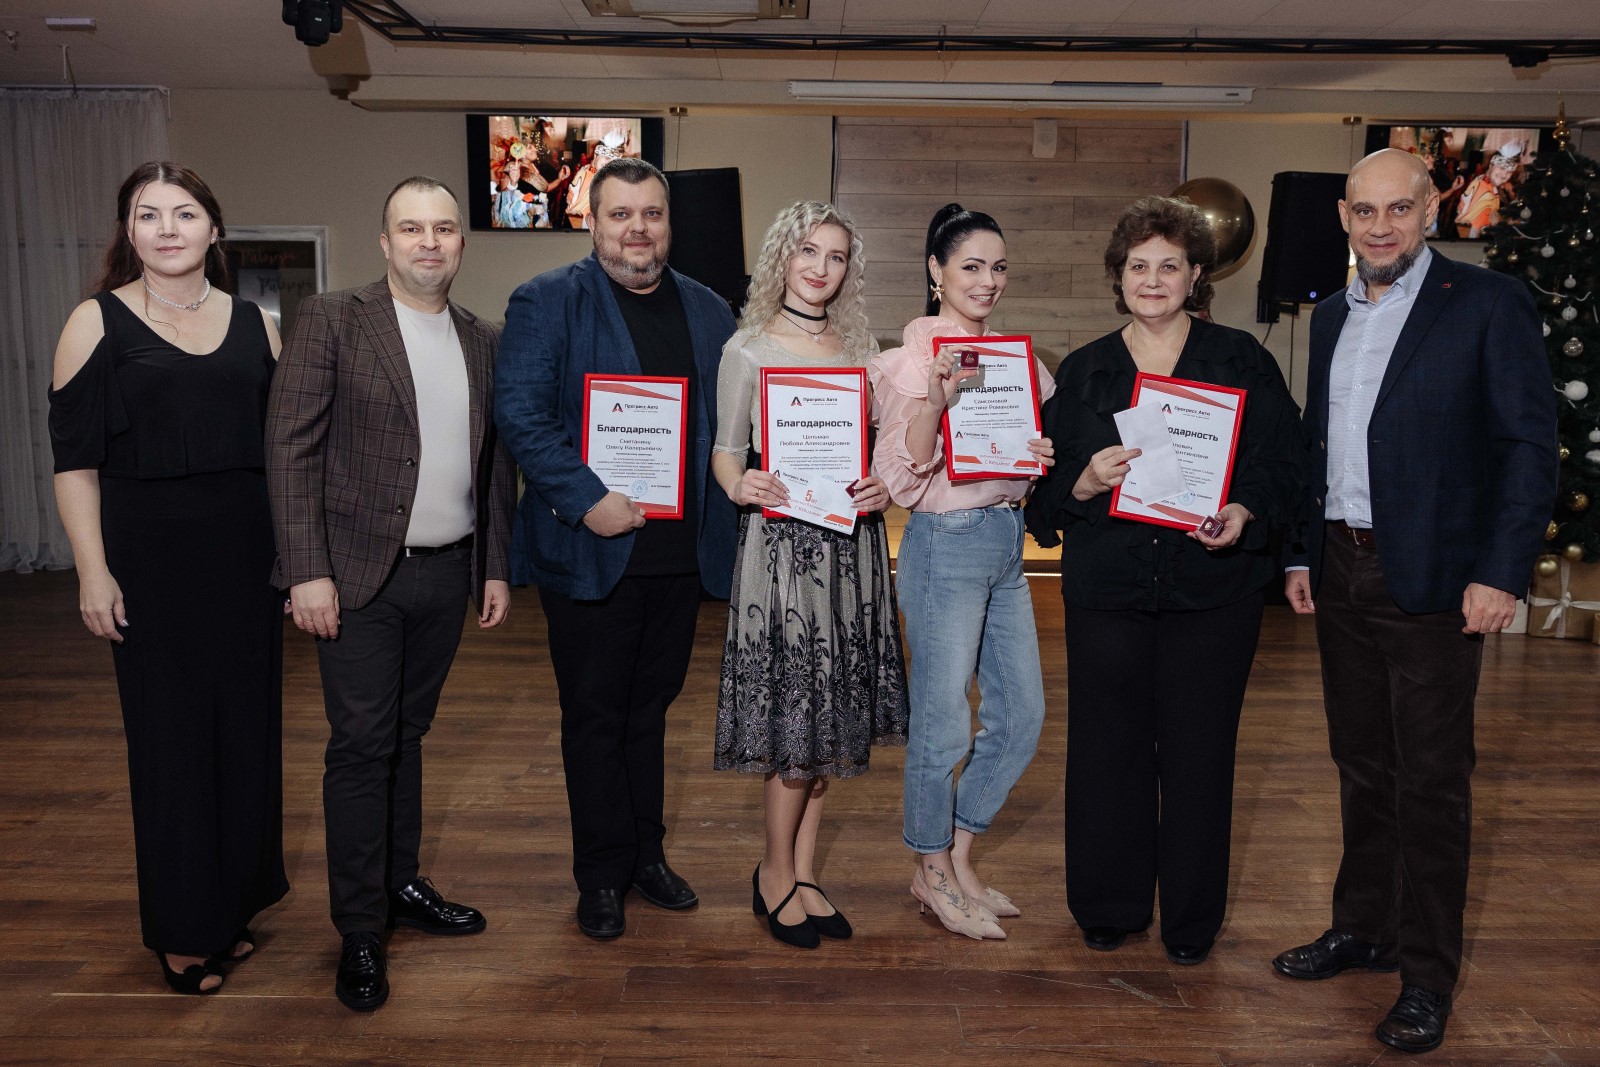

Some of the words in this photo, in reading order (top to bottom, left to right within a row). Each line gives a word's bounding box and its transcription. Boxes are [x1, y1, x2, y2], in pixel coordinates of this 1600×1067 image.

[1174, 405, 1197, 413] Прогресс
[597, 424, 672, 435] Благодарность
[776, 419, 853, 429] Благодарность
[1167, 426, 1219, 442] одарность
[990, 442, 997, 455] 5
[805, 489, 813, 502] 5
